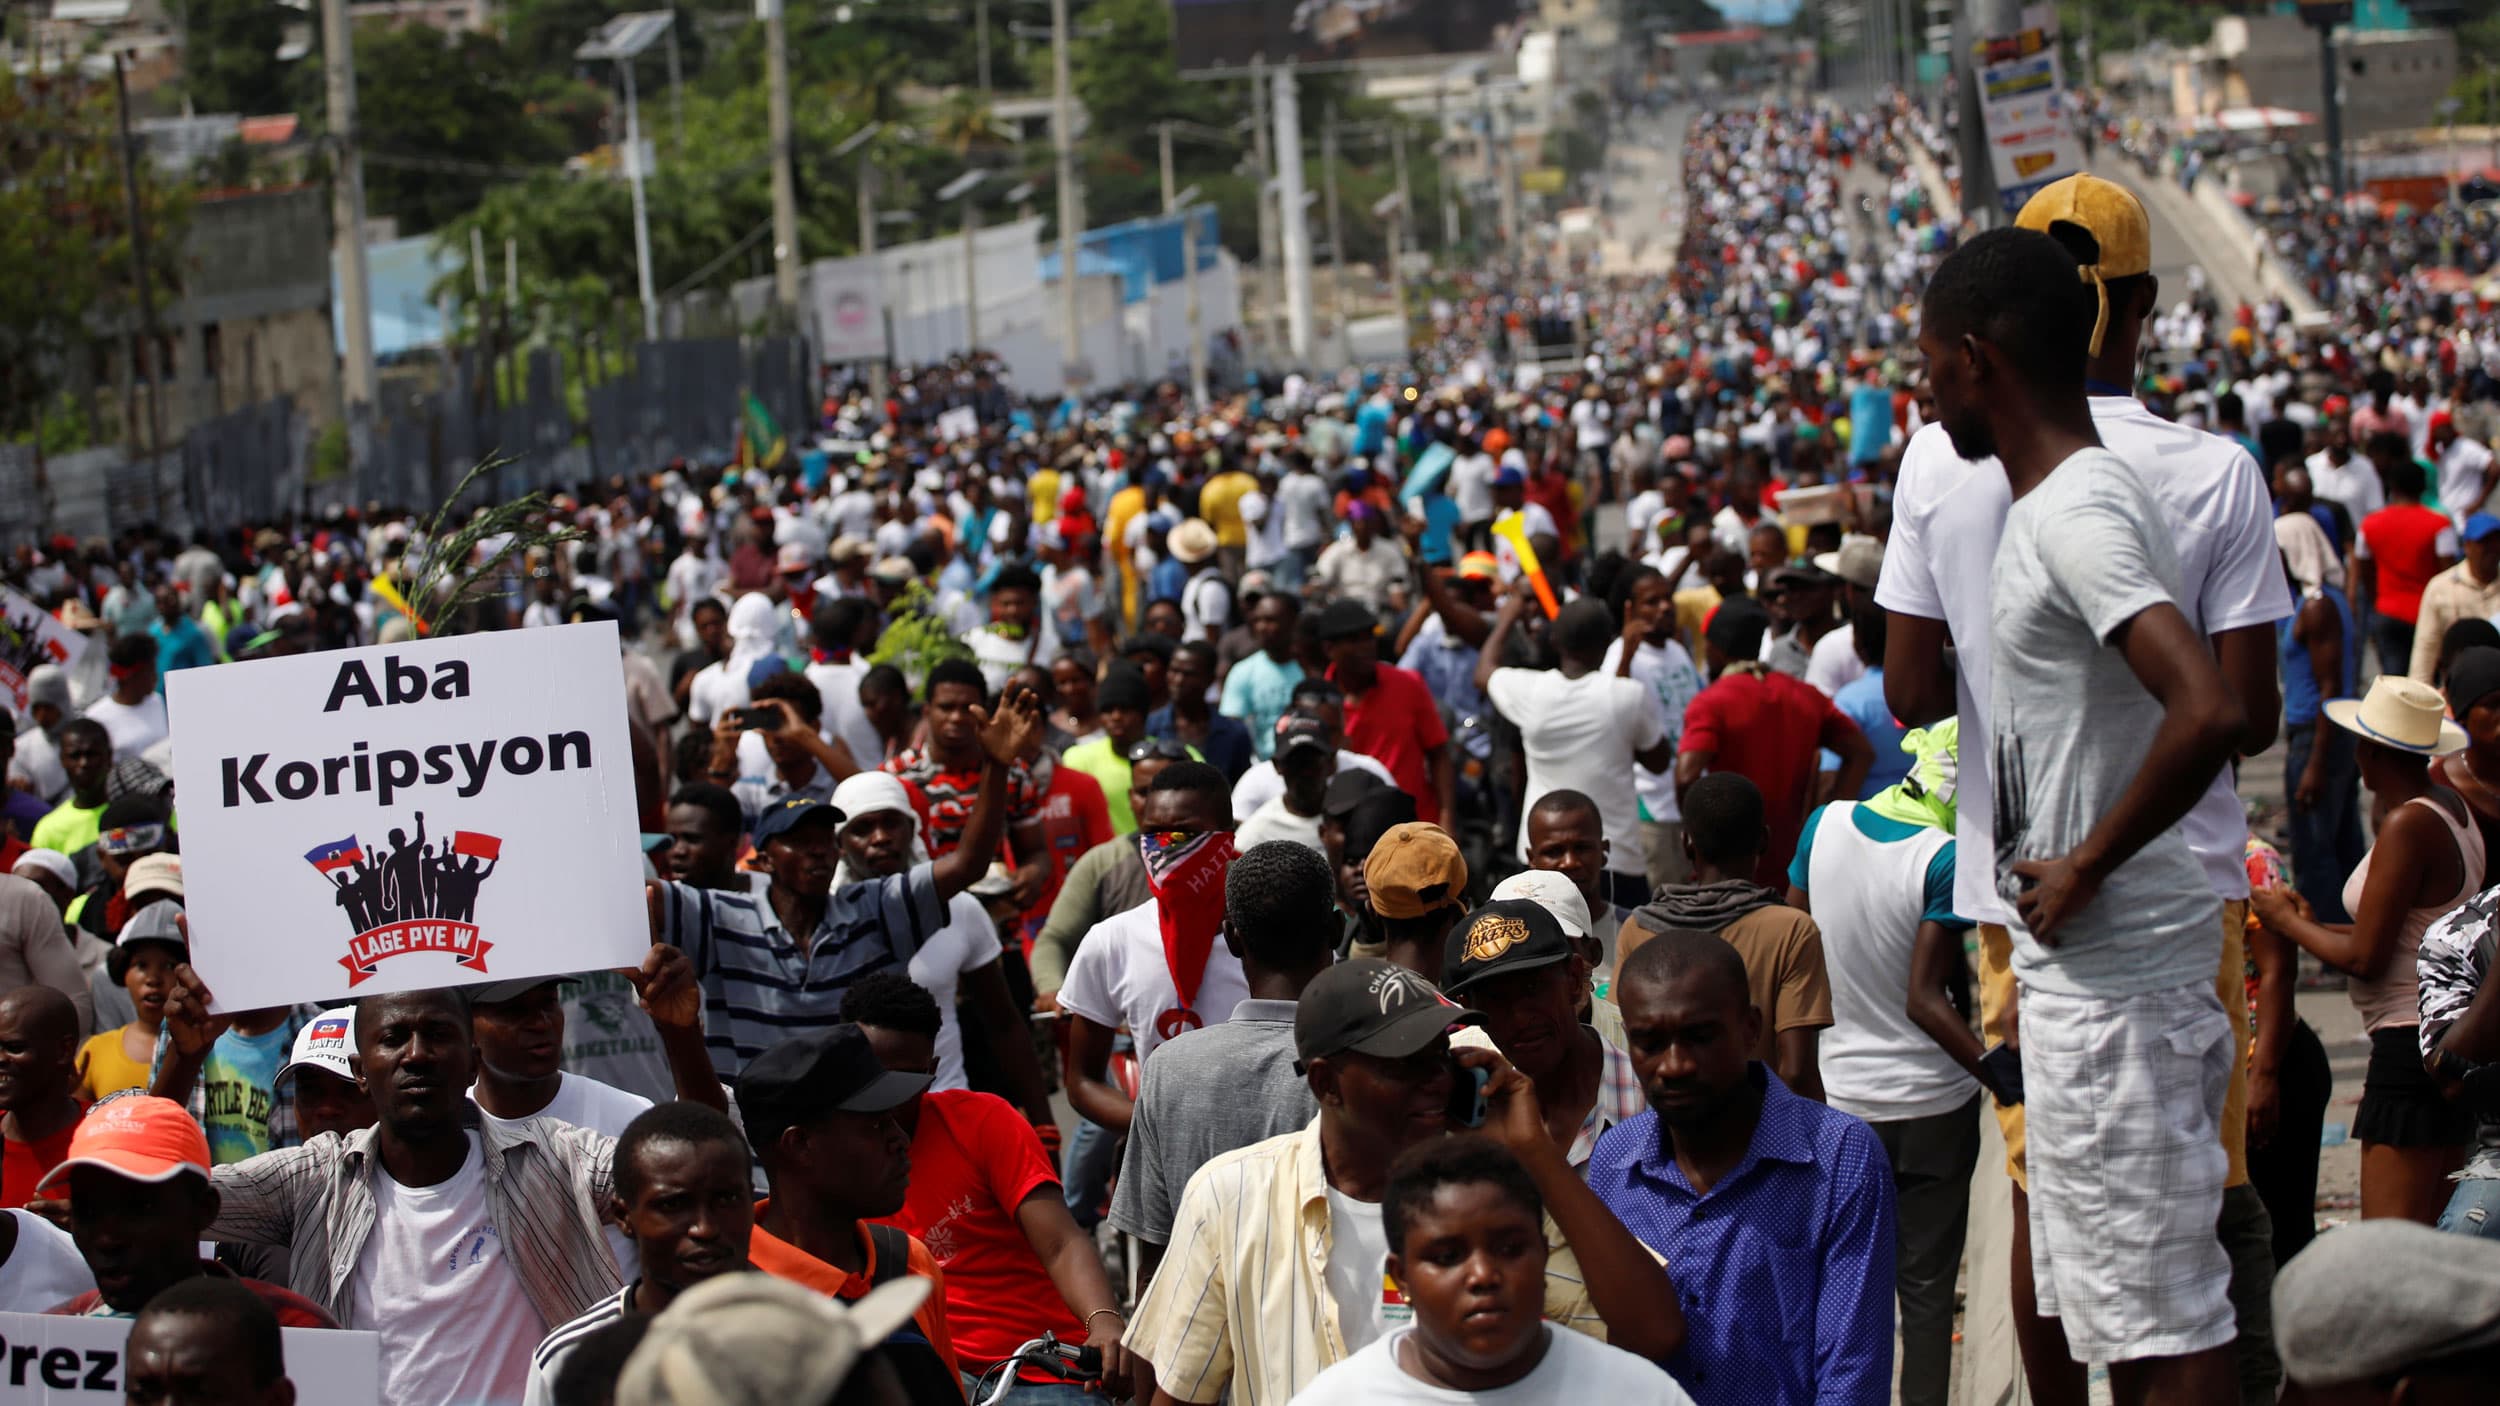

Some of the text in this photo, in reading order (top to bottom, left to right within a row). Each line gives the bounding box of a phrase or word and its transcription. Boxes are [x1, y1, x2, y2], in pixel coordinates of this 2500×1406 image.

[323, 656, 470, 713] Aba
[221, 730, 592, 808] Koripsyon
[1186, 837, 1235, 895] HAITI
[354, 925, 473, 961] LAGE PYE W
[1461, 922, 1526, 961] LAKERS
[0, 1333, 127, 1392] rez
